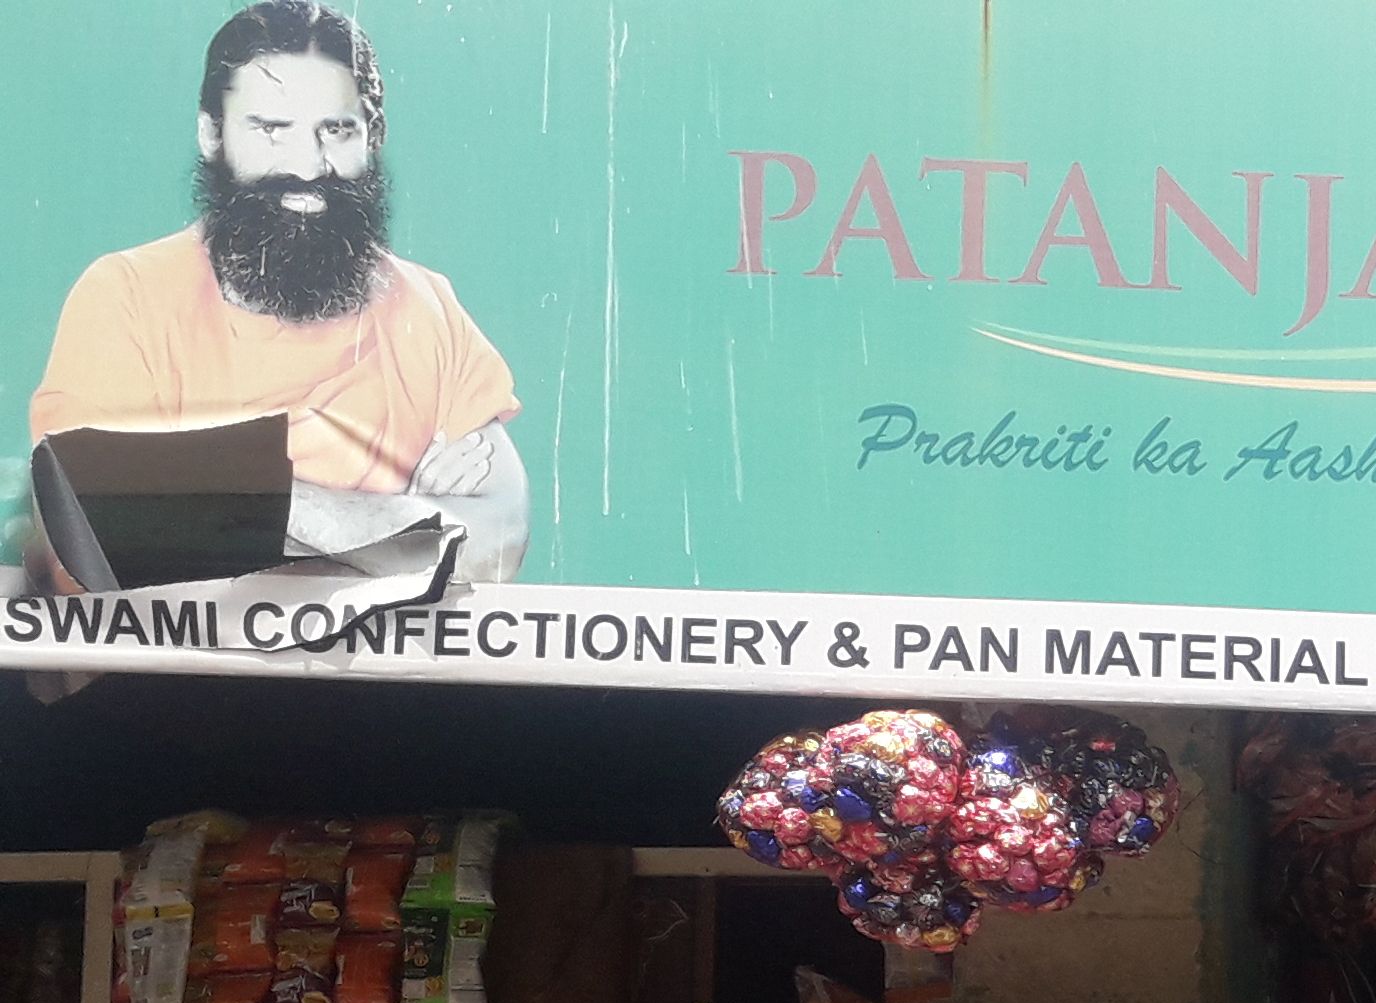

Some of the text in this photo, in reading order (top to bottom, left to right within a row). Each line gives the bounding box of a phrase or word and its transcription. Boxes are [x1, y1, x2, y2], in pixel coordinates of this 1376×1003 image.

[856, 404, 1110, 473] Prakriti
[1130, 417, 1206, 476] ka
[3, 596, 218, 648] SWAMI
[243, 601, 808, 666] CONFECTIONERY
[827, 620, 868, 668] &
[895, 623, 1020, 673] PAN
[1042, 628, 1370, 687] MATERIAL
